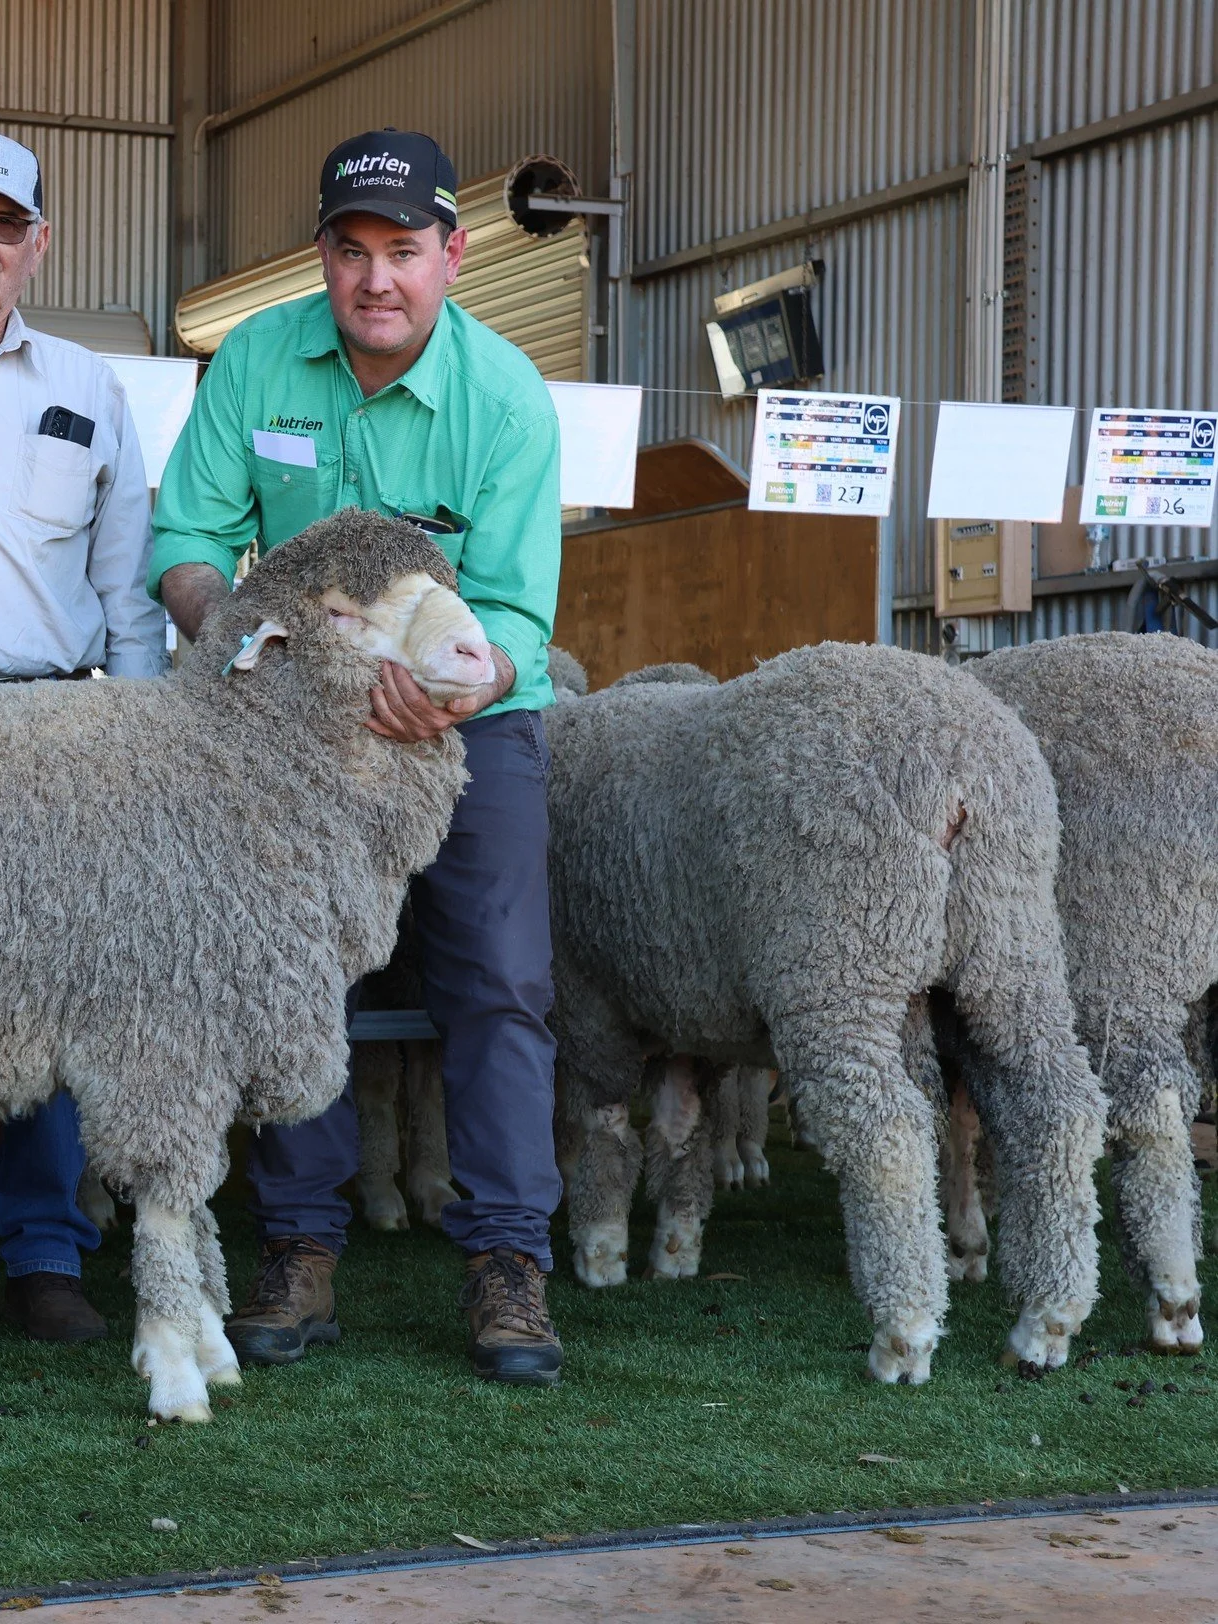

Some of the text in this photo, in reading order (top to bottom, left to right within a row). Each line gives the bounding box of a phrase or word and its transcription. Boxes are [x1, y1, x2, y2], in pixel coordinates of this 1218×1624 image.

[335, 152, 411, 180] Nutrien
[352, 175, 406, 188] Livestock
[269, 414, 323, 431] Nutrien
[838, 486, 864, 504] 27
[1100, 499, 1124, 508] Nutrien
[1163, 498, 1185, 515] 26
